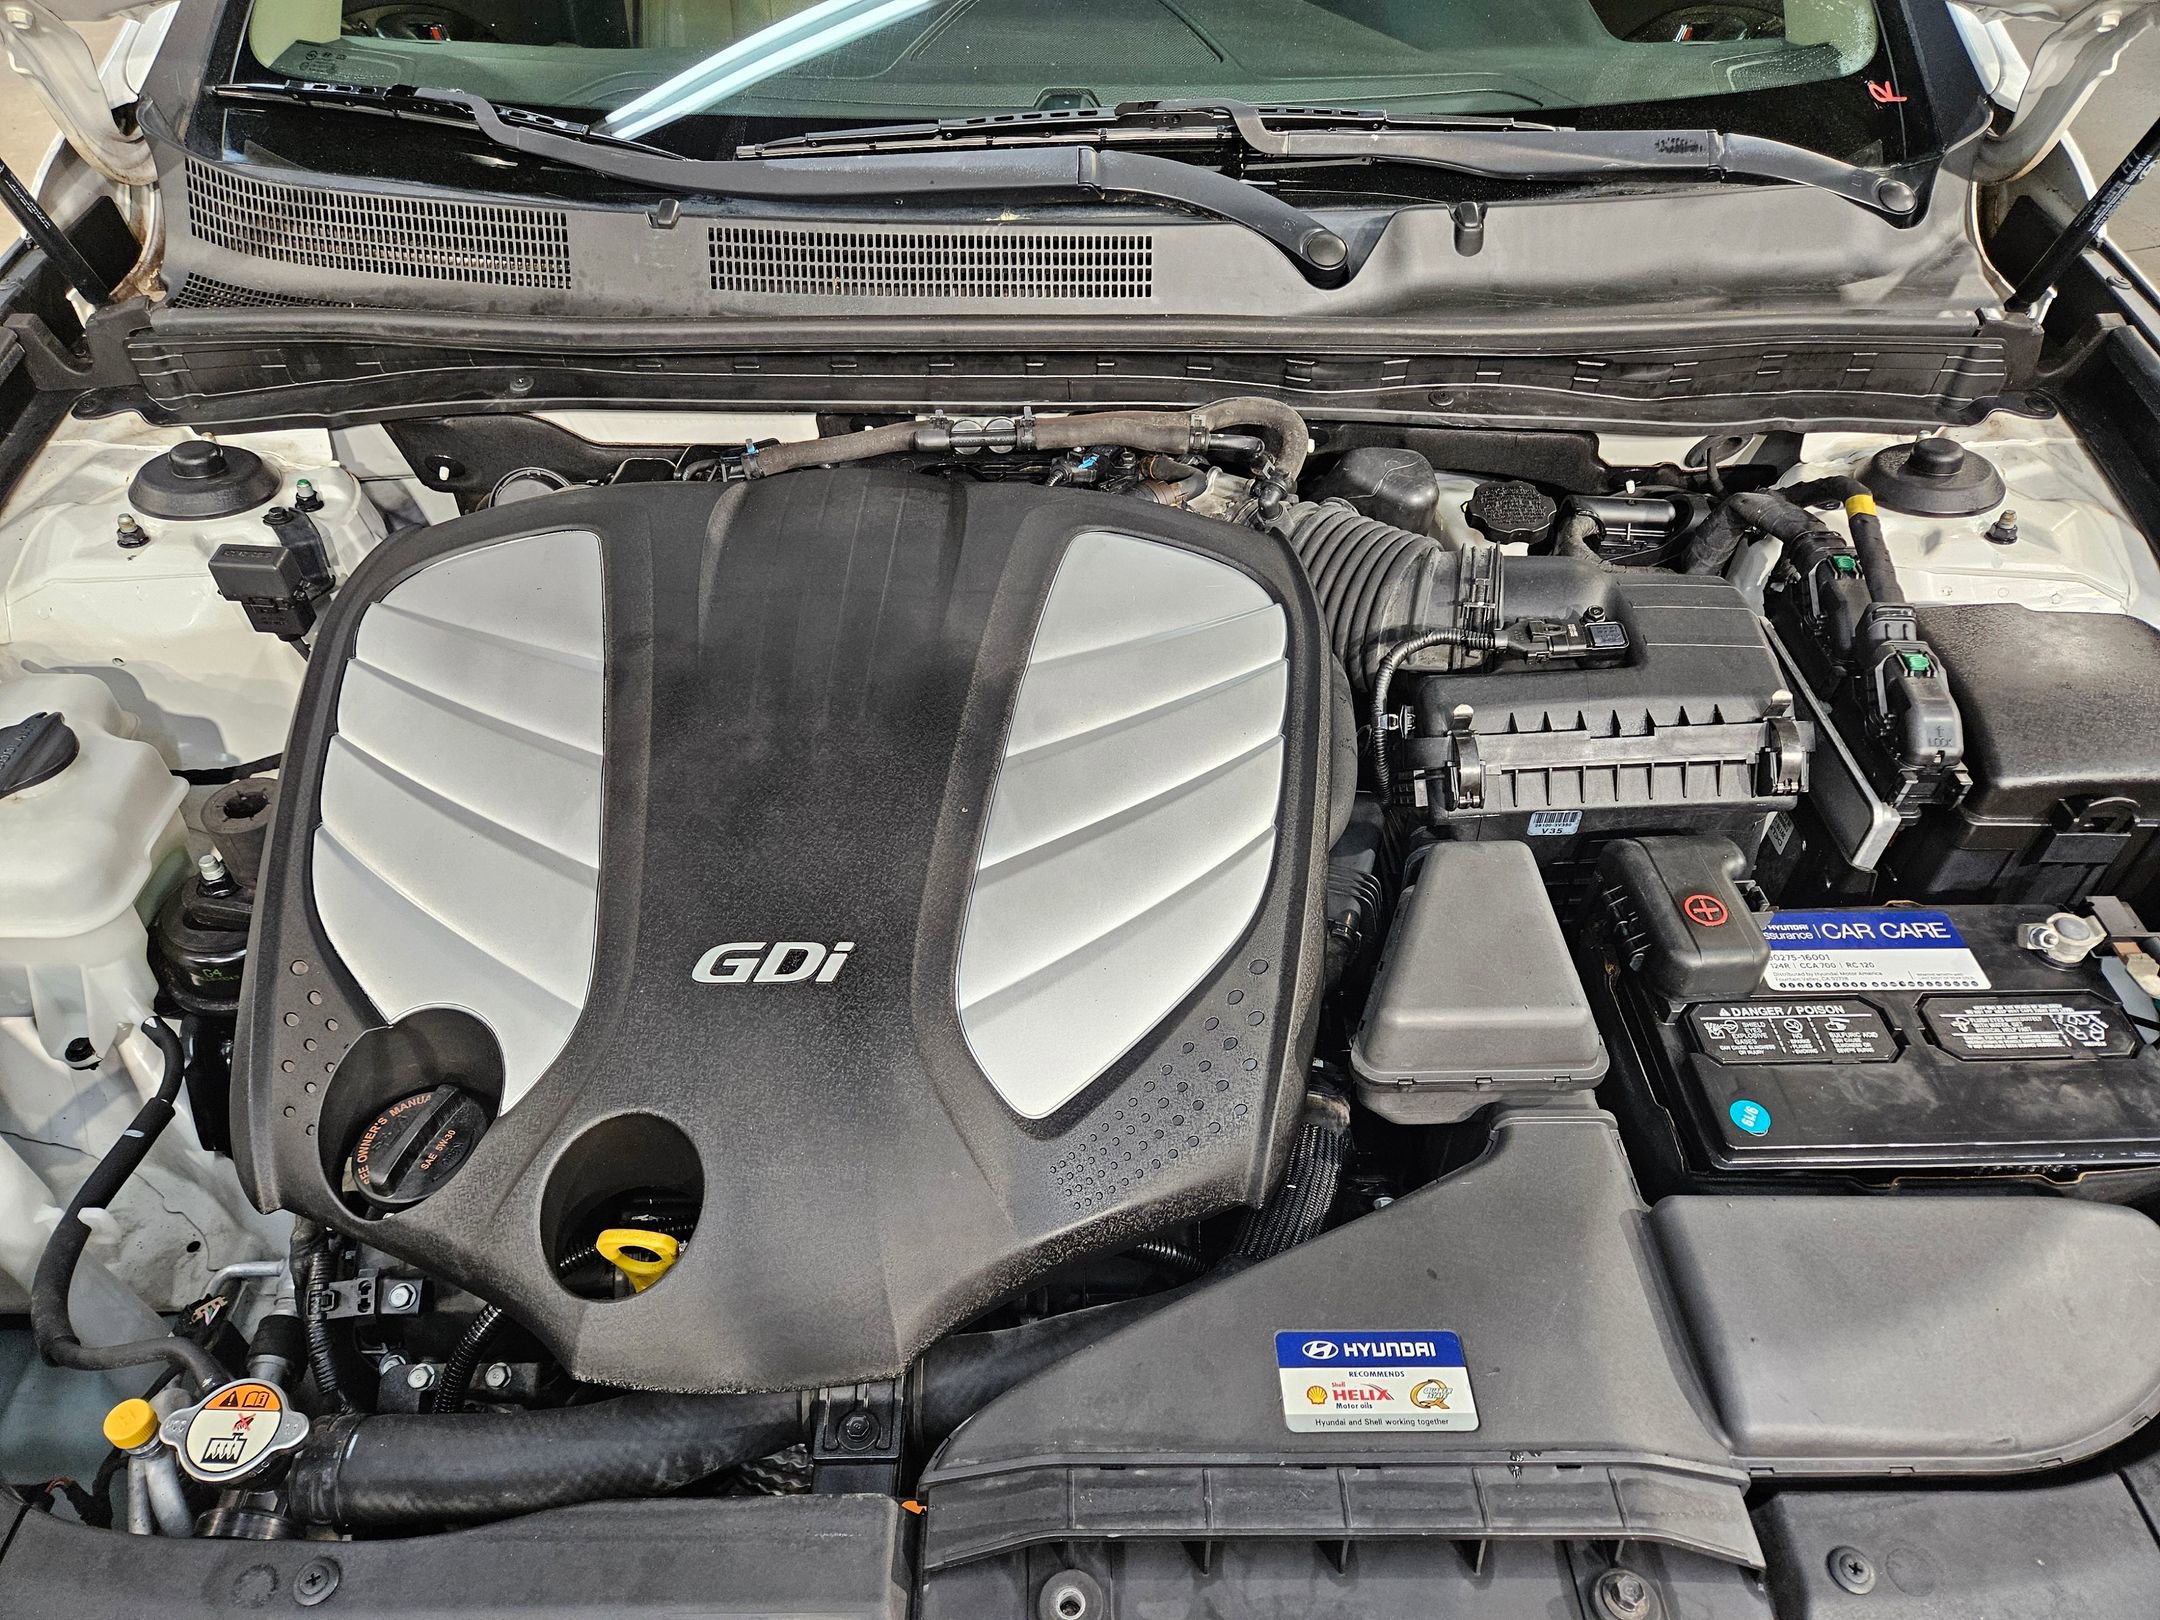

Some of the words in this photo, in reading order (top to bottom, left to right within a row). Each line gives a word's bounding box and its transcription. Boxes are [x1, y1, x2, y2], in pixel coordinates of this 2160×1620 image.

[1765, 932, 1814, 940] ssurance
[1822, 924, 1876, 940] CAR
[1880, 922, 1951, 938] CARE
[692, 942, 856, 983] GDi
[1731, 1007, 1783, 1016] DANGER
[1796, 1005, 1845, 1015] POISON
[357, 1117, 388, 1163] OWNER'S
[389, 1094, 432, 1117] MANUA
[421, 1152, 437, 1170] SAE
[436, 1130, 456, 1152] 5W-30
[1343, 1342, 1436, 1358] HYUNDAI
[1333, 1389, 1394, 1400] HELIX
[1386, 1418, 1415, 1426] working
[1418, 1418, 1448, 1427] together
